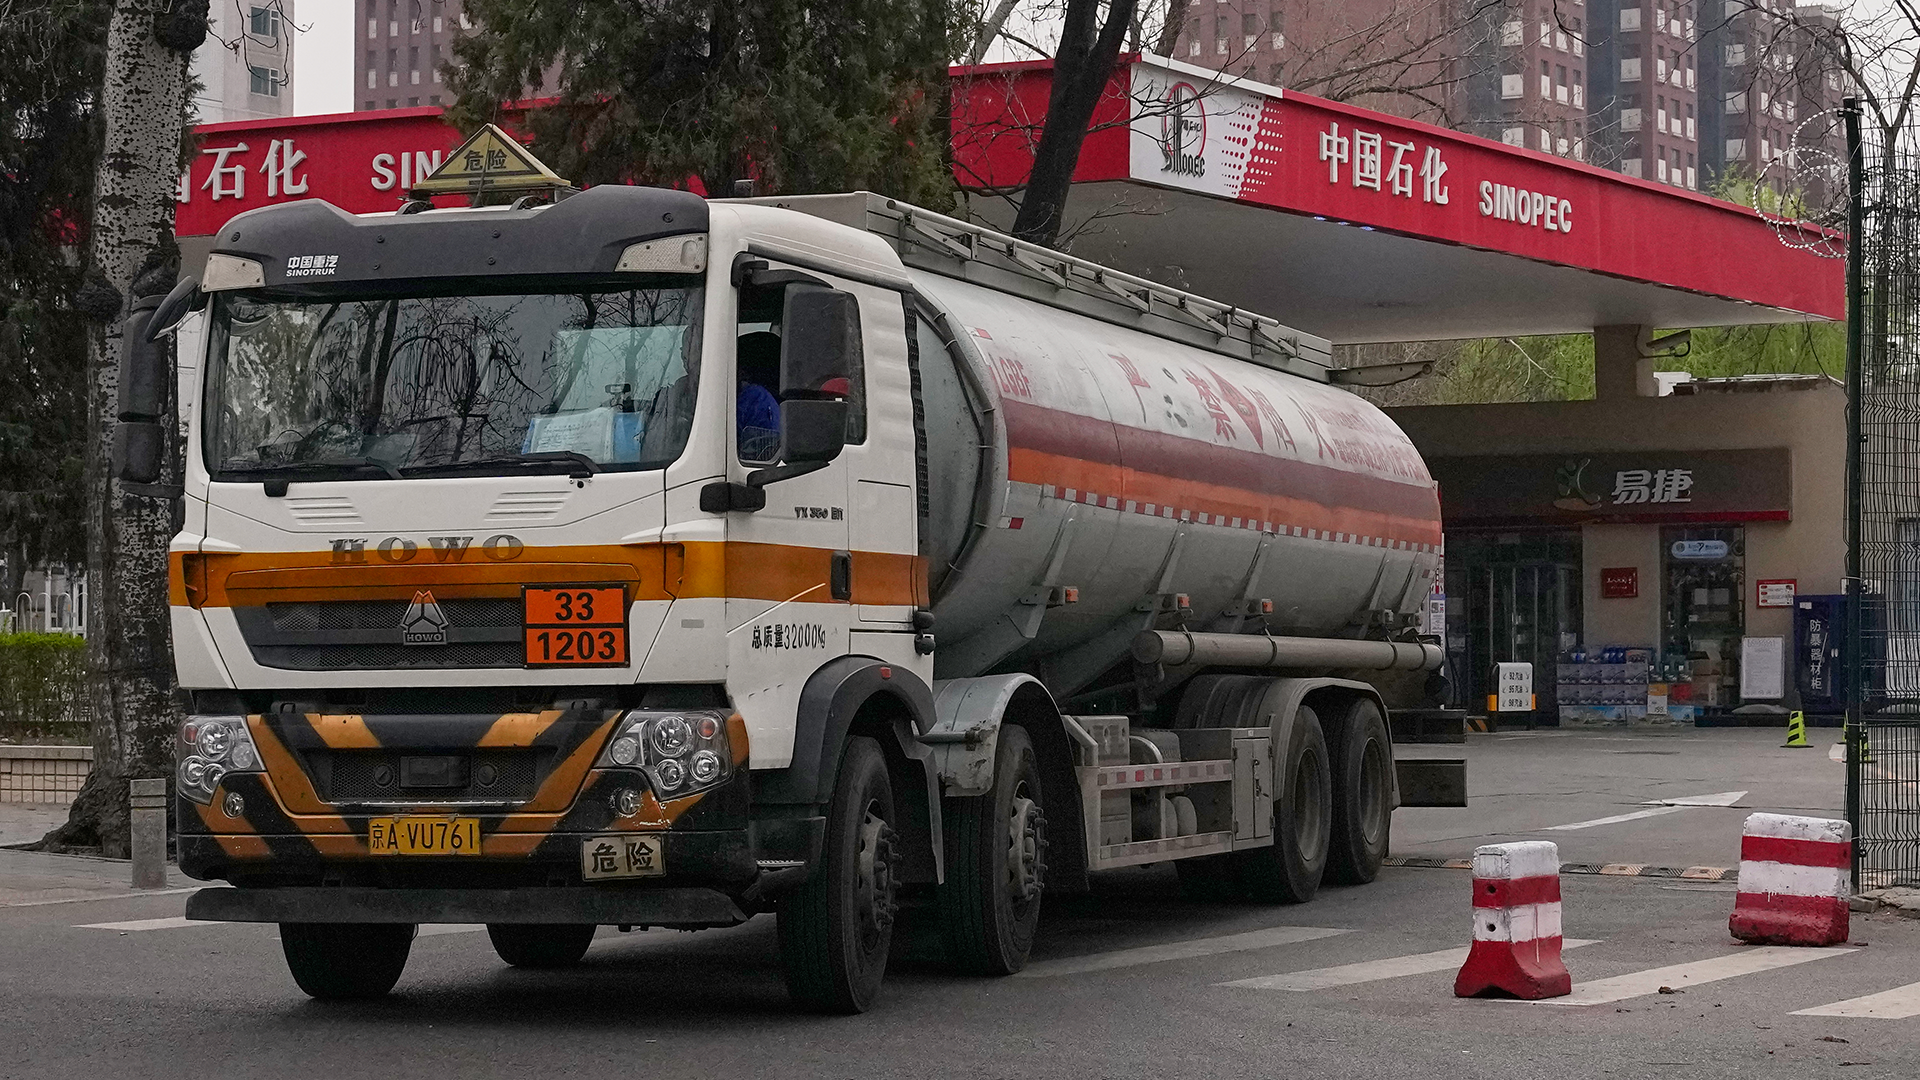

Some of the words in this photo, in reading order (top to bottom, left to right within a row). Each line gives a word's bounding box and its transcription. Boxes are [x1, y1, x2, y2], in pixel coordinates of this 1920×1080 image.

[174, 138, 309, 203] 石化
[371, 148, 455, 190] SIN
[463, 149, 508, 172] 危险
[1319, 121, 1449, 205] 中国石化
[1479, 180, 1573, 234] SINOPEC
[286, 267, 337, 277] SINOTRUK
[287, 255, 339, 269] 中国重汽
[1611, 468, 1694, 505] 易捷
[329, 534, 524, 564] HOWO
[555, 591, 594, 622] 33
[406, 633, 442, 642] HOWO
[537, 631, 616, 661] 1203
[591, 841, 655, 874] 危险
